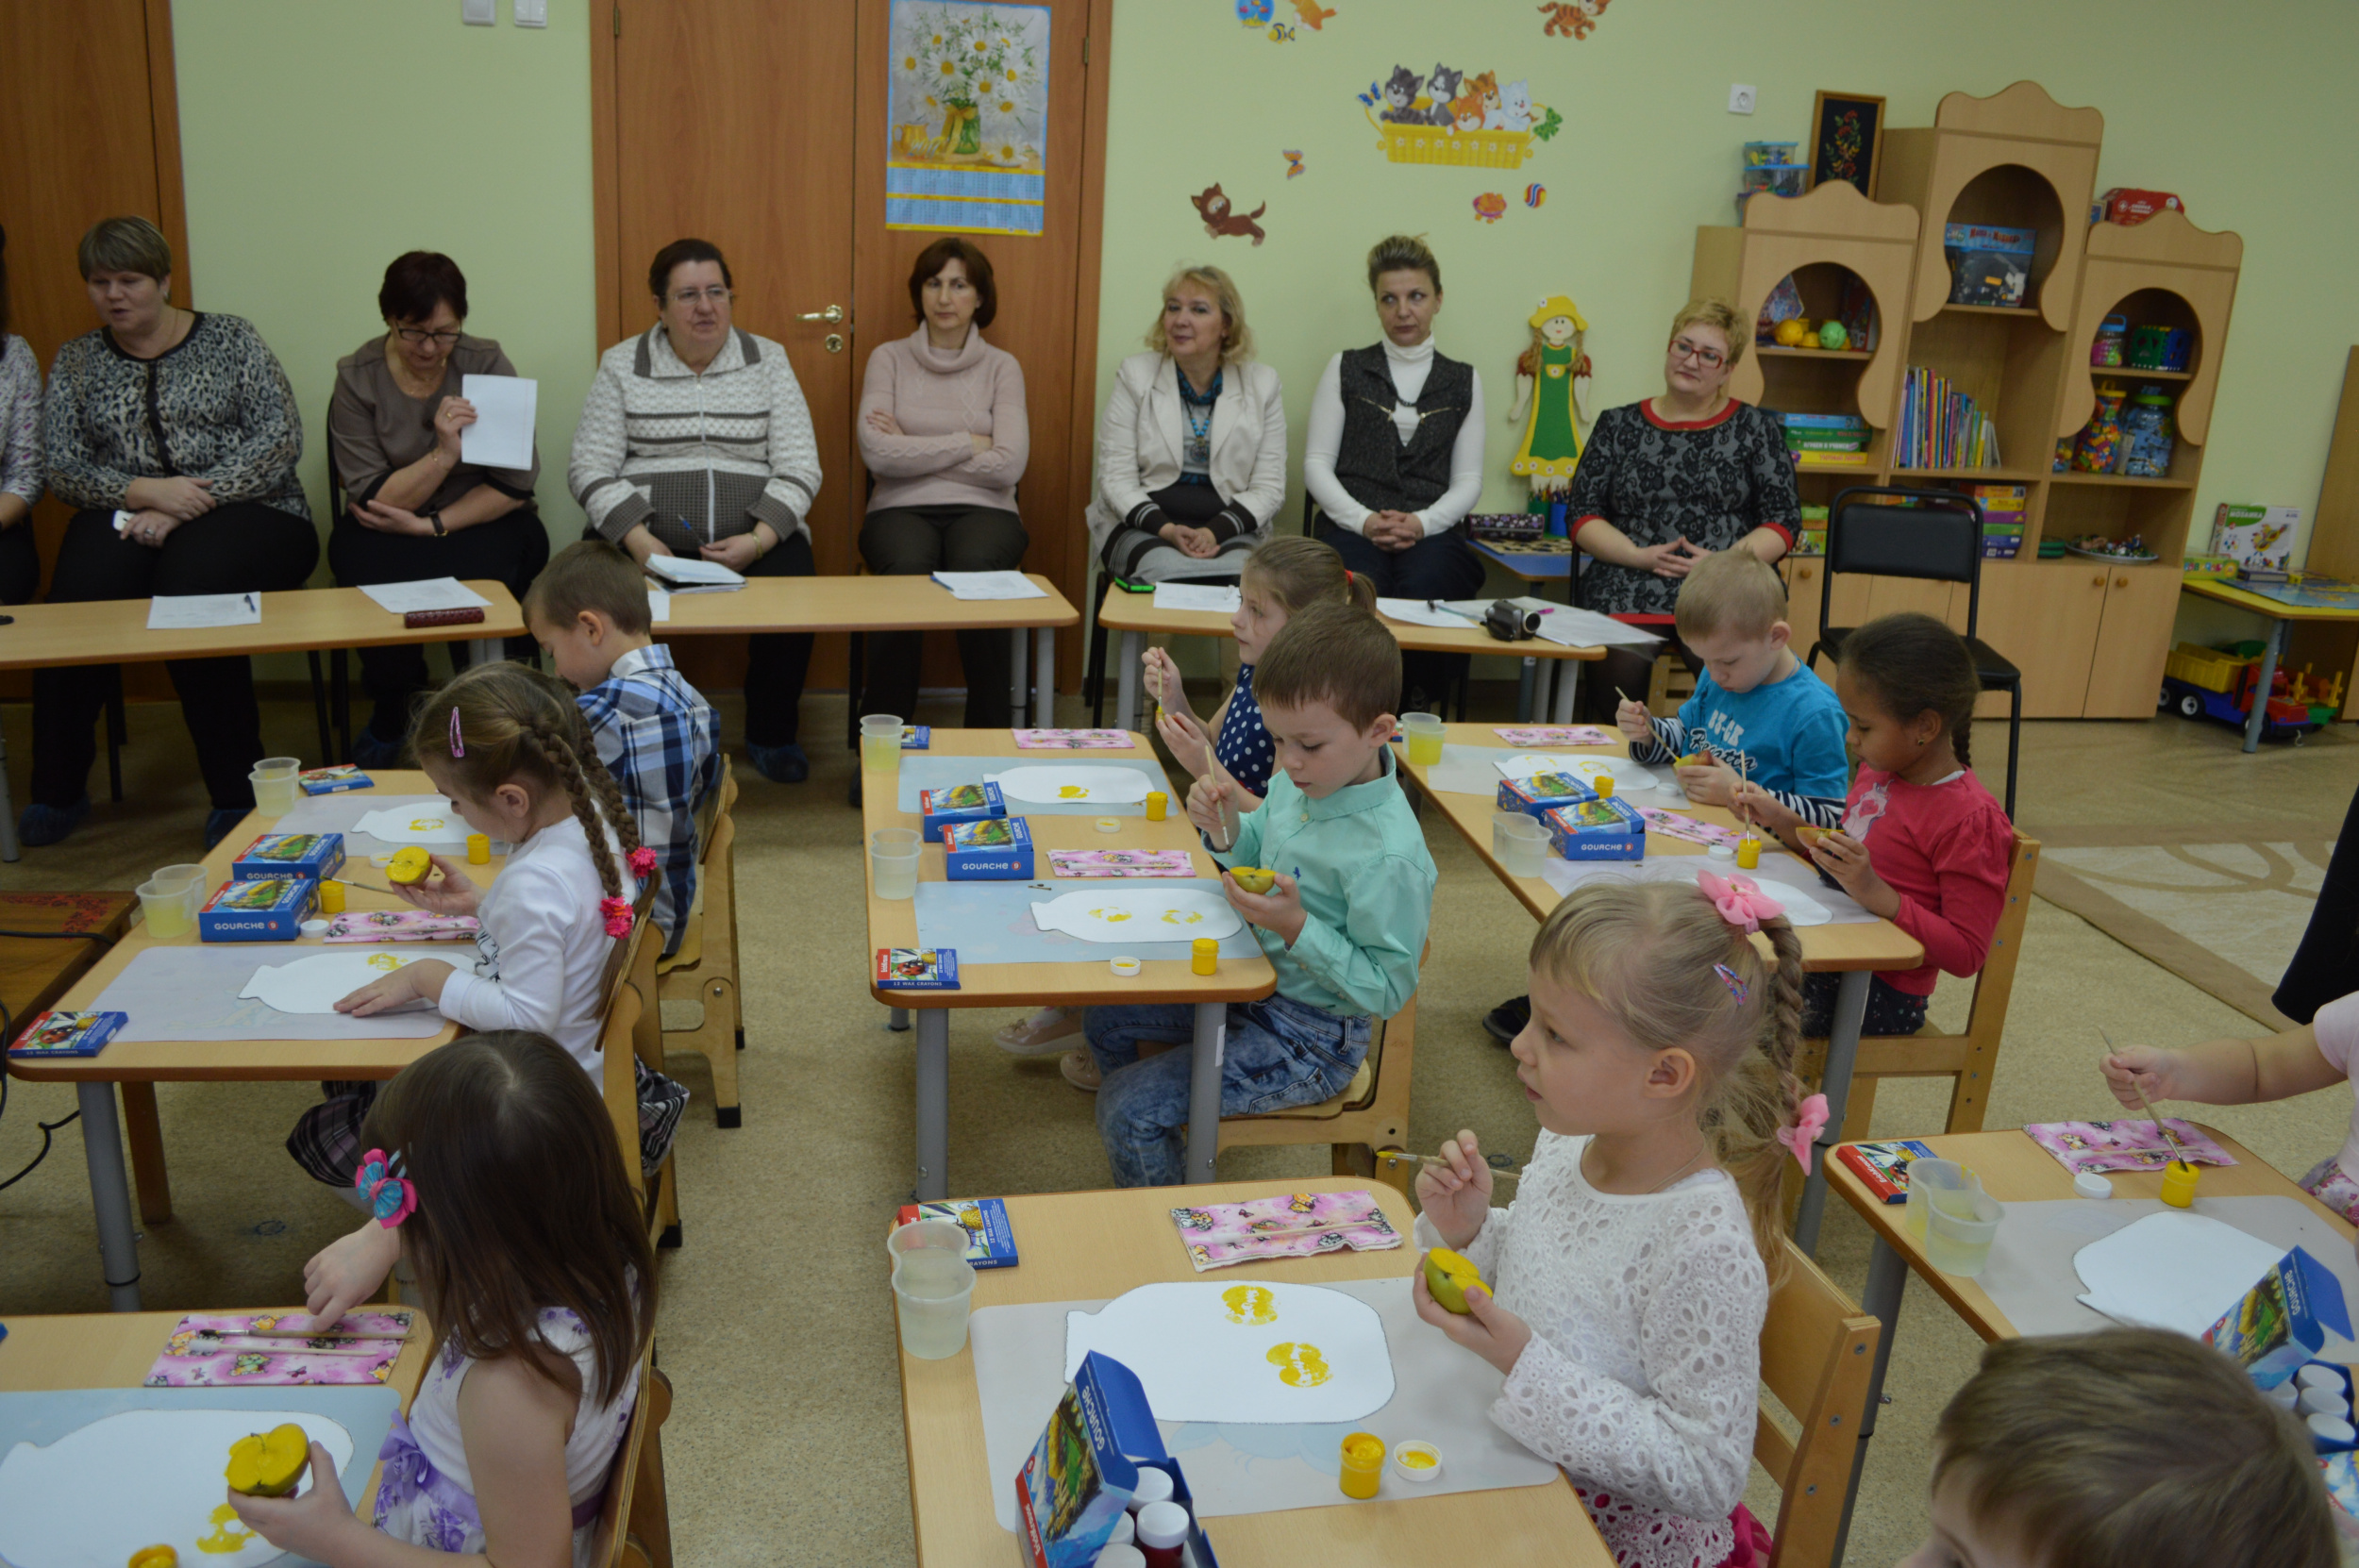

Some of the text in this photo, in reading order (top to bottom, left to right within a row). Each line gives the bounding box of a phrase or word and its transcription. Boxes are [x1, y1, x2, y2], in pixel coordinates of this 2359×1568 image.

[214, 922, 265, 930] GOUACHE
[2284, 1269, 2300, 1316] GOUACHE
[1081, 1385, 1105, 1451] GOUACHE
